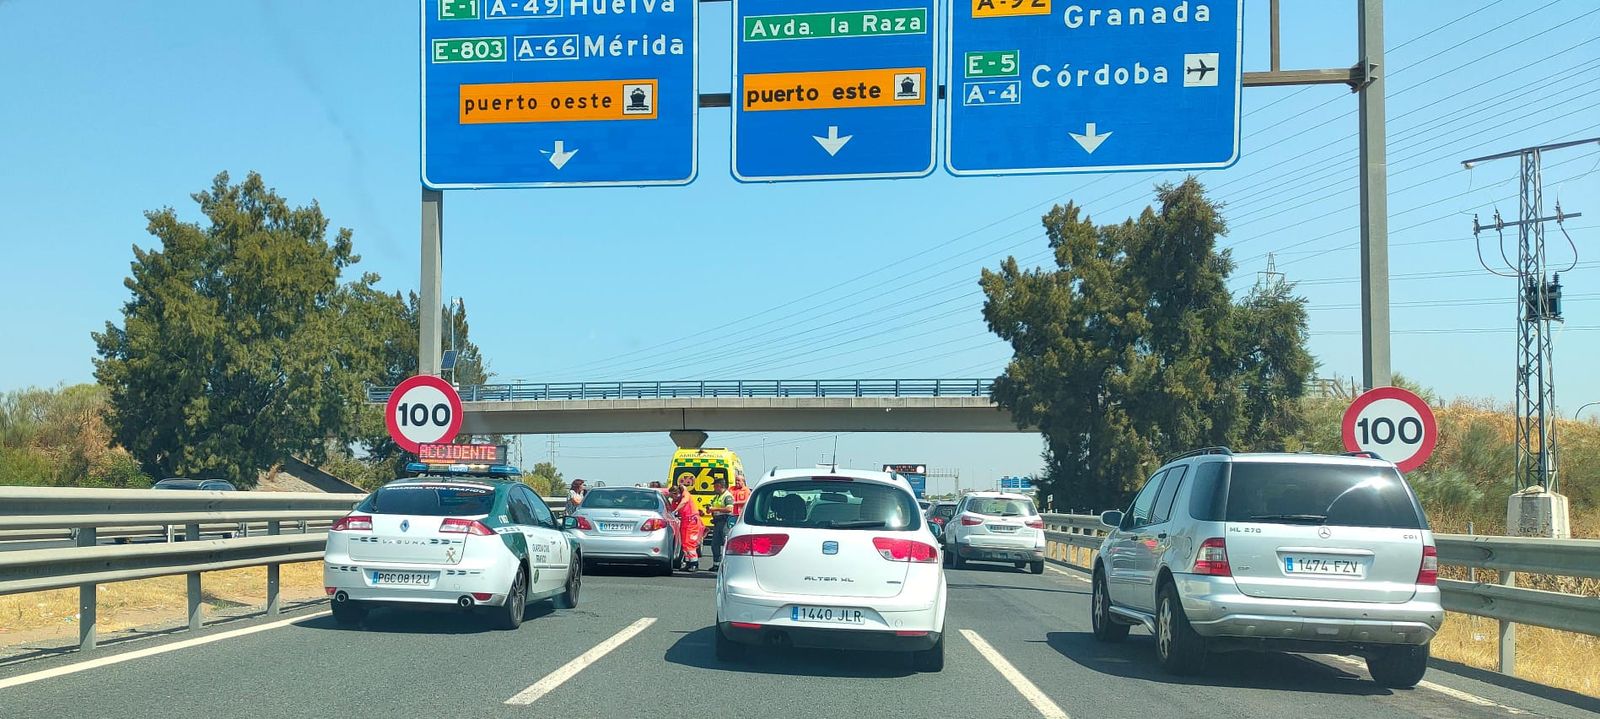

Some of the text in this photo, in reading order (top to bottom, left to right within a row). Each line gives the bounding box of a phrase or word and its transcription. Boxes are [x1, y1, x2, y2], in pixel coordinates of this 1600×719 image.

[441, 0, 675, 16] E-1 A-49 Huelva
[1063, 1, 1210, 29] Granada
[750, 14, 922, 38] Avda. la Raza
[434, 34, 685, 60] E-803 A-66 Mérida
[968, 54, 1016, 75] E-5
[1031, 62, 1169, 88] Córdoba
[464, 93, 613, 114] puerto oeste
[746, 82, 882, 107] puerto este
[966, 83, 1018, 103] A-4
[398, 402, 451, 427] 100
[1357, 415, 1423, 445] 100
[419, 443, 497, 461] ACCIDENTE
[1298, 559, 1358, 573] 1474 FZV
[801, 608, 862, 623] 1440 JLR
